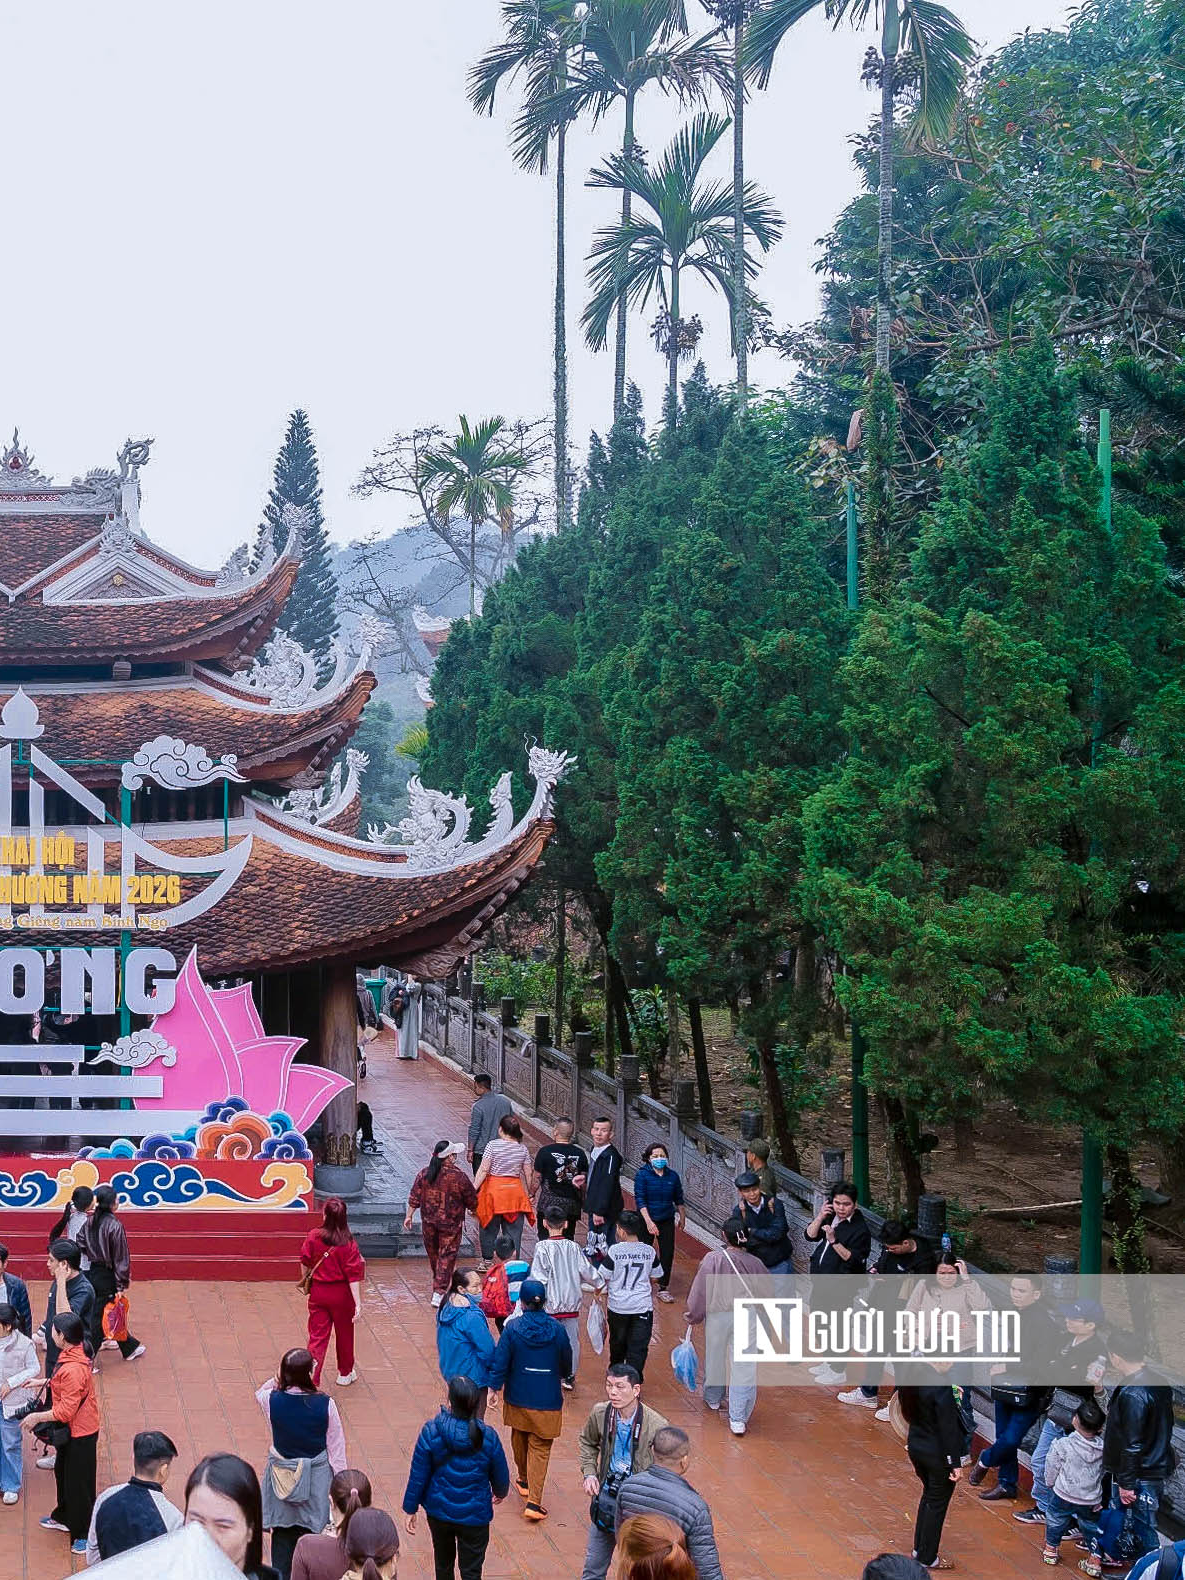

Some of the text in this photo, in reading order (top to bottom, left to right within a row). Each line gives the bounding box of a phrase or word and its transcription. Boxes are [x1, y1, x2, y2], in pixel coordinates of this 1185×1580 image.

[41, 831, 75, 869] HỘI
[73, 869, 121, 904] NĂM
[127, 875, 180, 904] 2026
[18, 914, 60, 929] Giêng
[139, 914, 168, 930] Ngọ
[622, 1262, 645, 1290] 17
